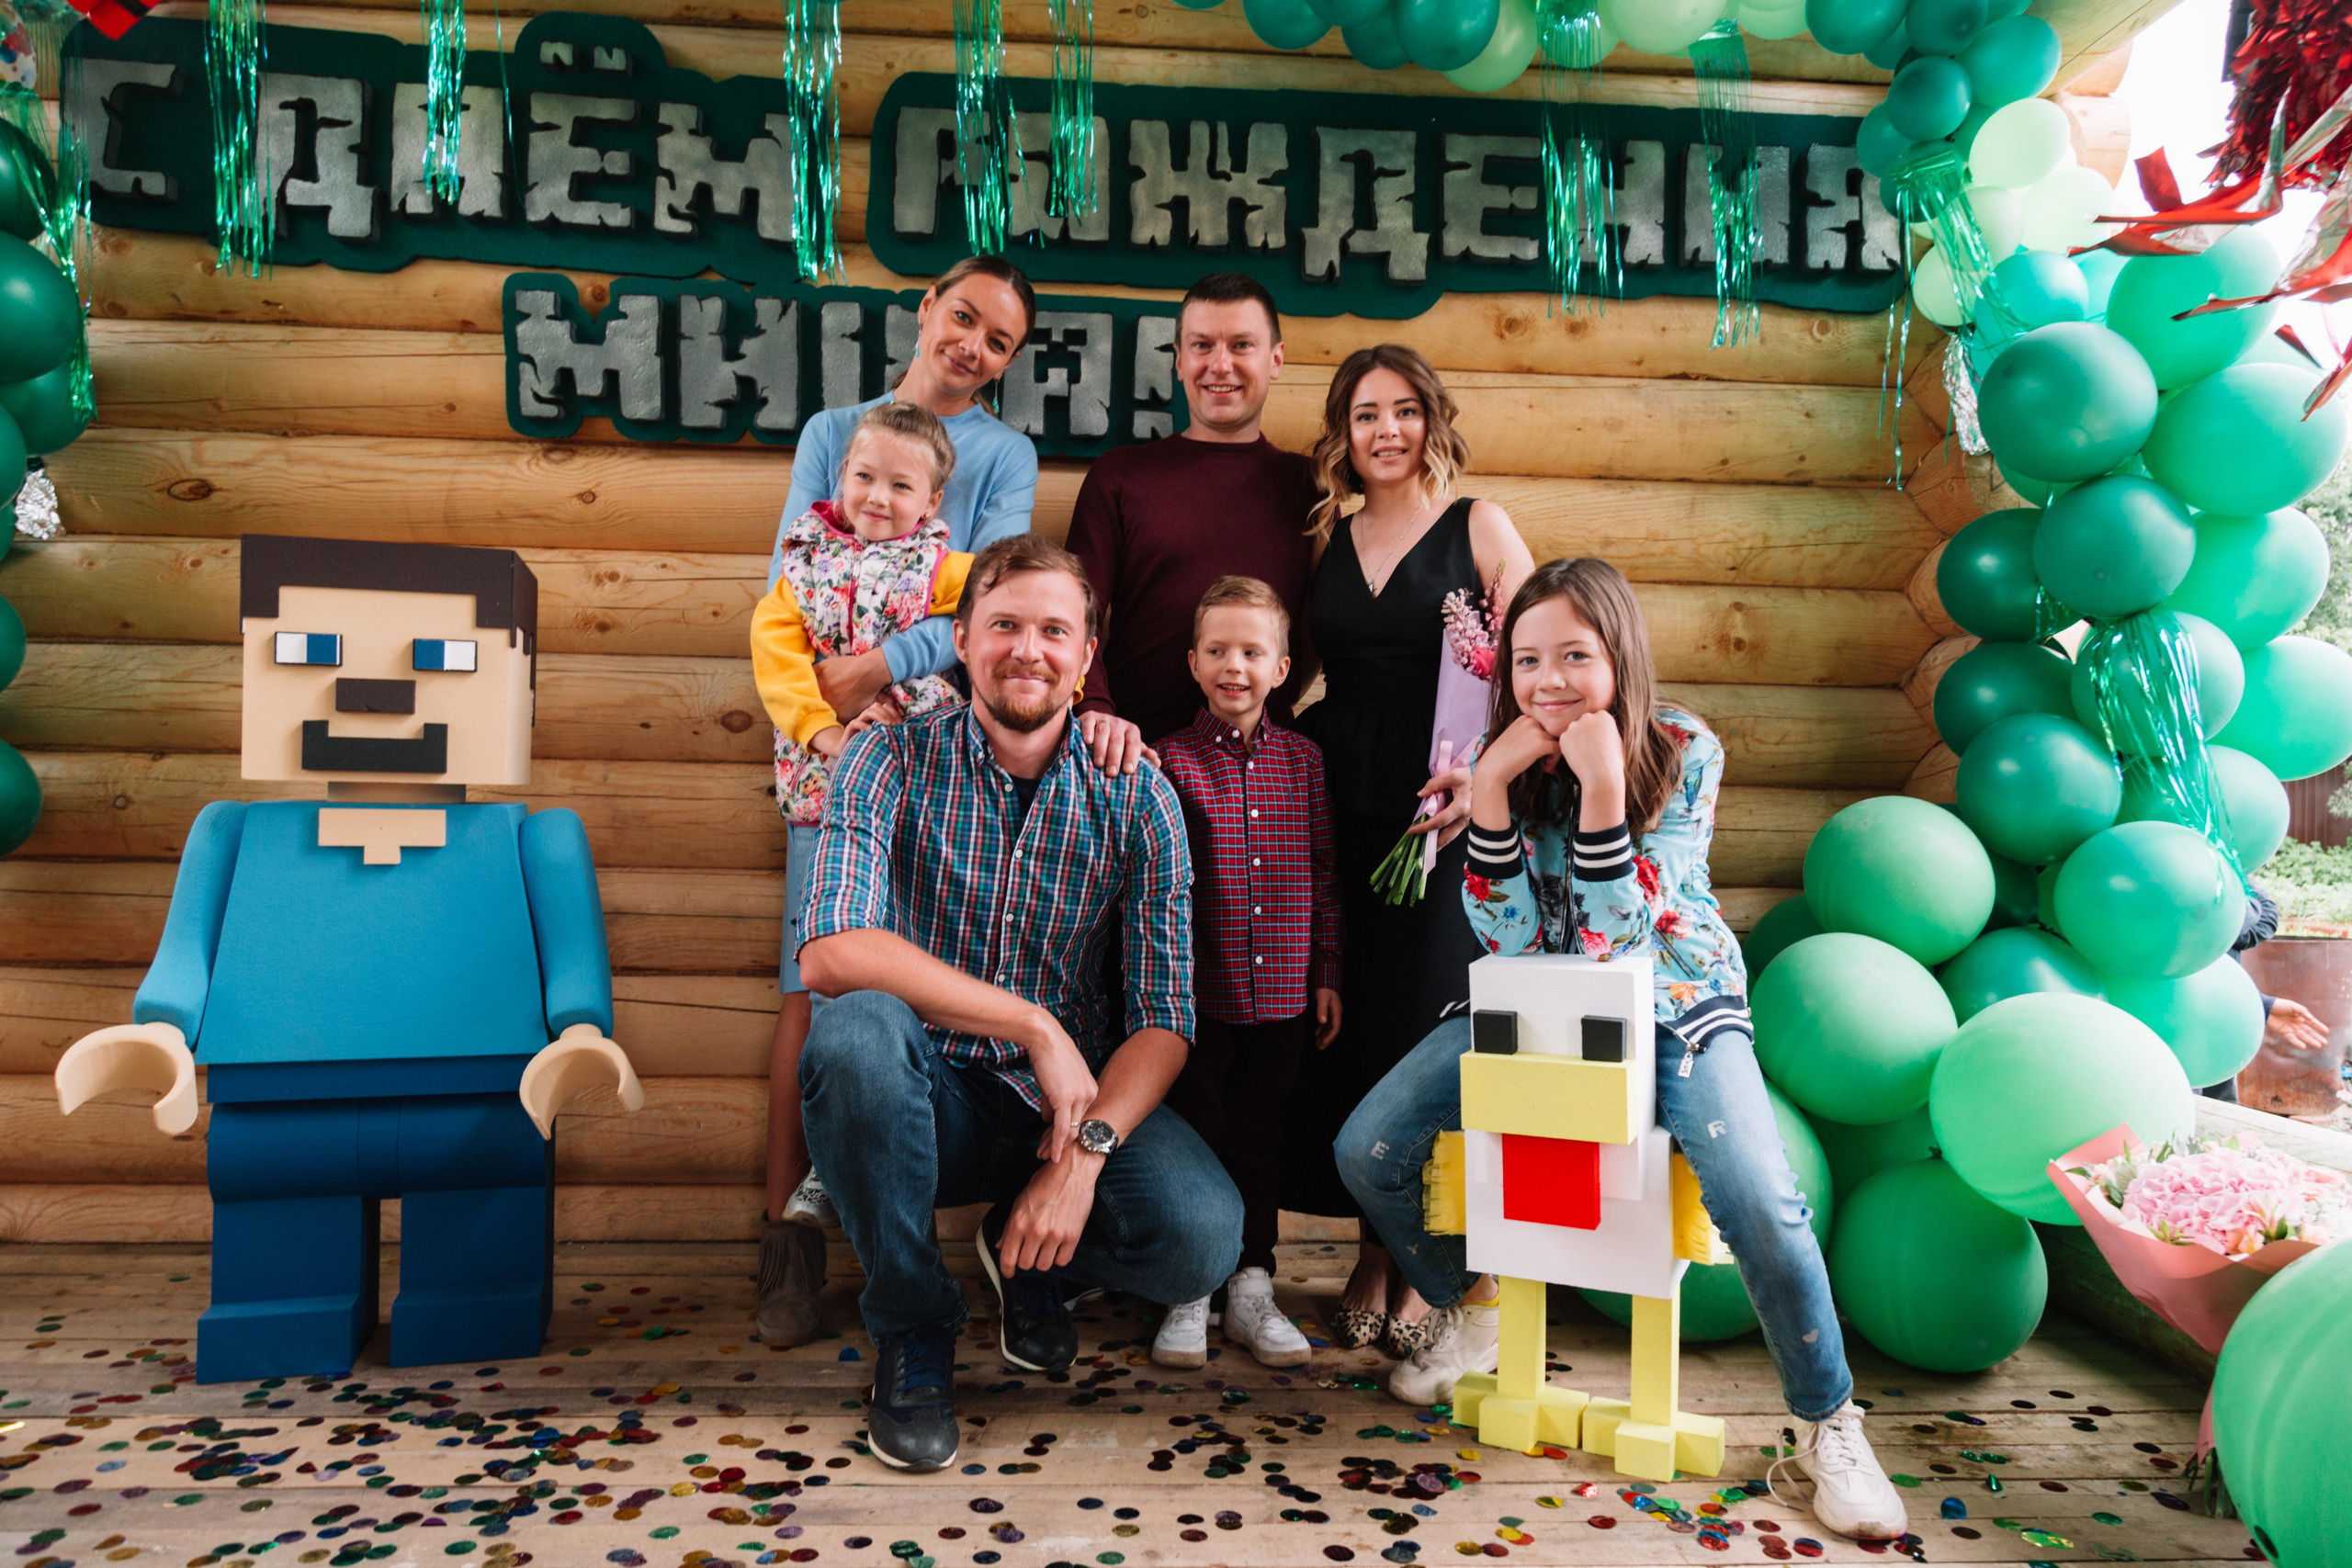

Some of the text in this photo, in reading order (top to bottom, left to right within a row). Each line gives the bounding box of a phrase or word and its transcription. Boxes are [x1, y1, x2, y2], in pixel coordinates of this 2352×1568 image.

[62, 57, 180, 198] С
[235, 40, 808, 244] ДНЁМ
[1707, 1120, 1726, 1139] R
[1370, 1140, 1389, 1160] E
